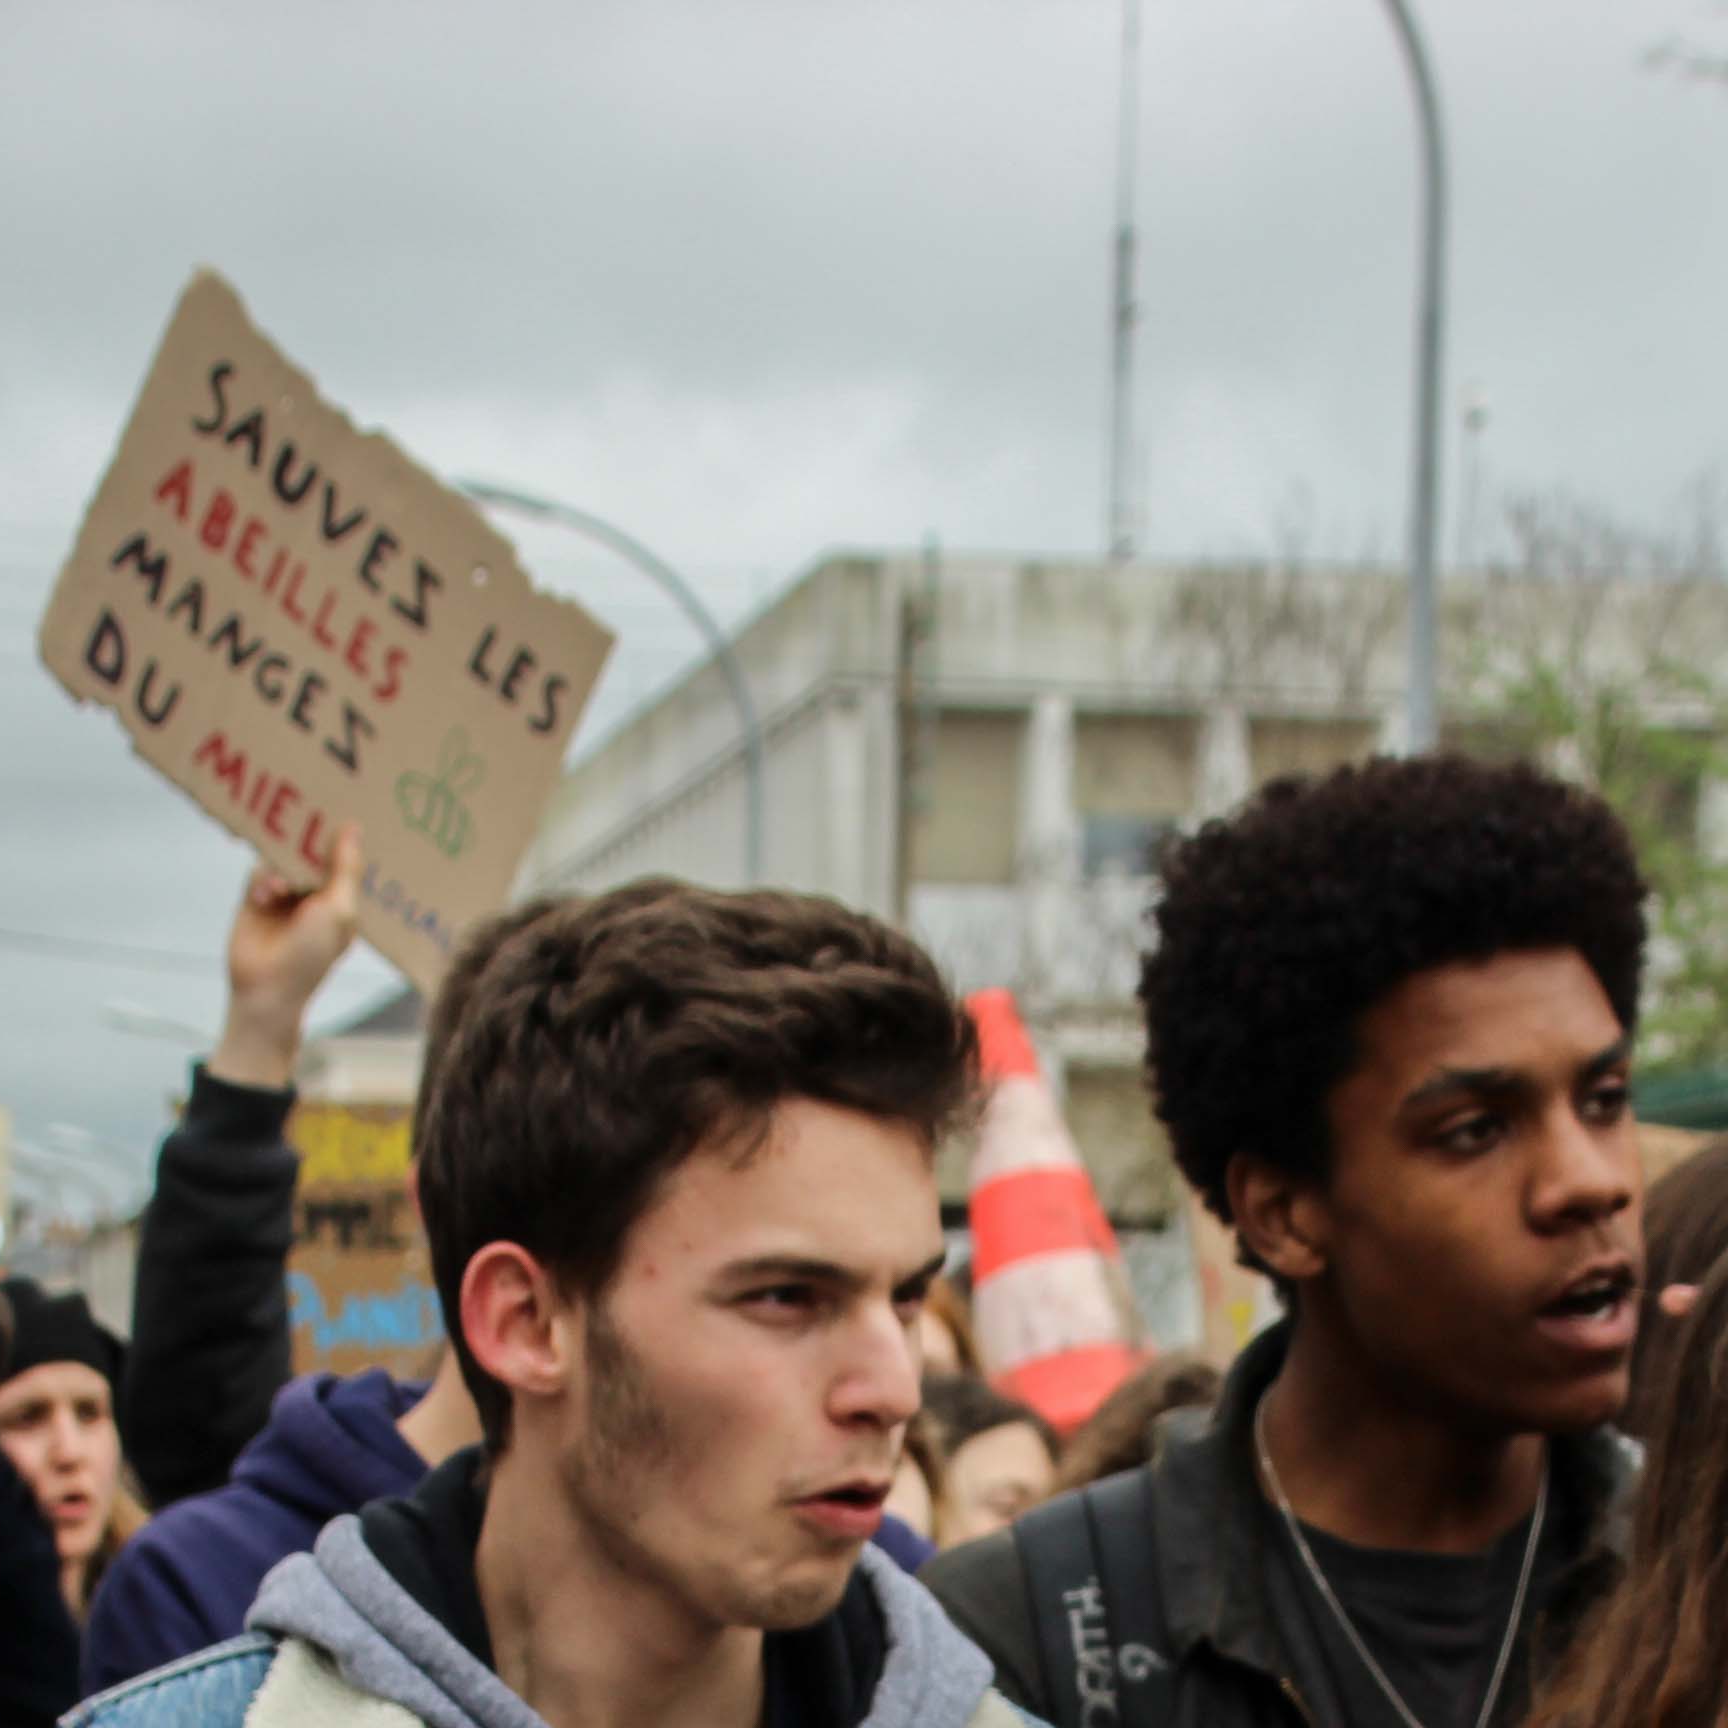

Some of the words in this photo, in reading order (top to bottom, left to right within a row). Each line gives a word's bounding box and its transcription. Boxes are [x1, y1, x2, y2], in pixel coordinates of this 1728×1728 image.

[84, 607, 182, 730] DU
[110, 531, 379, 773] MANGEZ
[153, 458, 410, 705] ABEILLES
[192, 359, 443, 633] SAUVEZ
[469, 624, 568, 736] LES
[195, 730, 329, 875] MIEL
